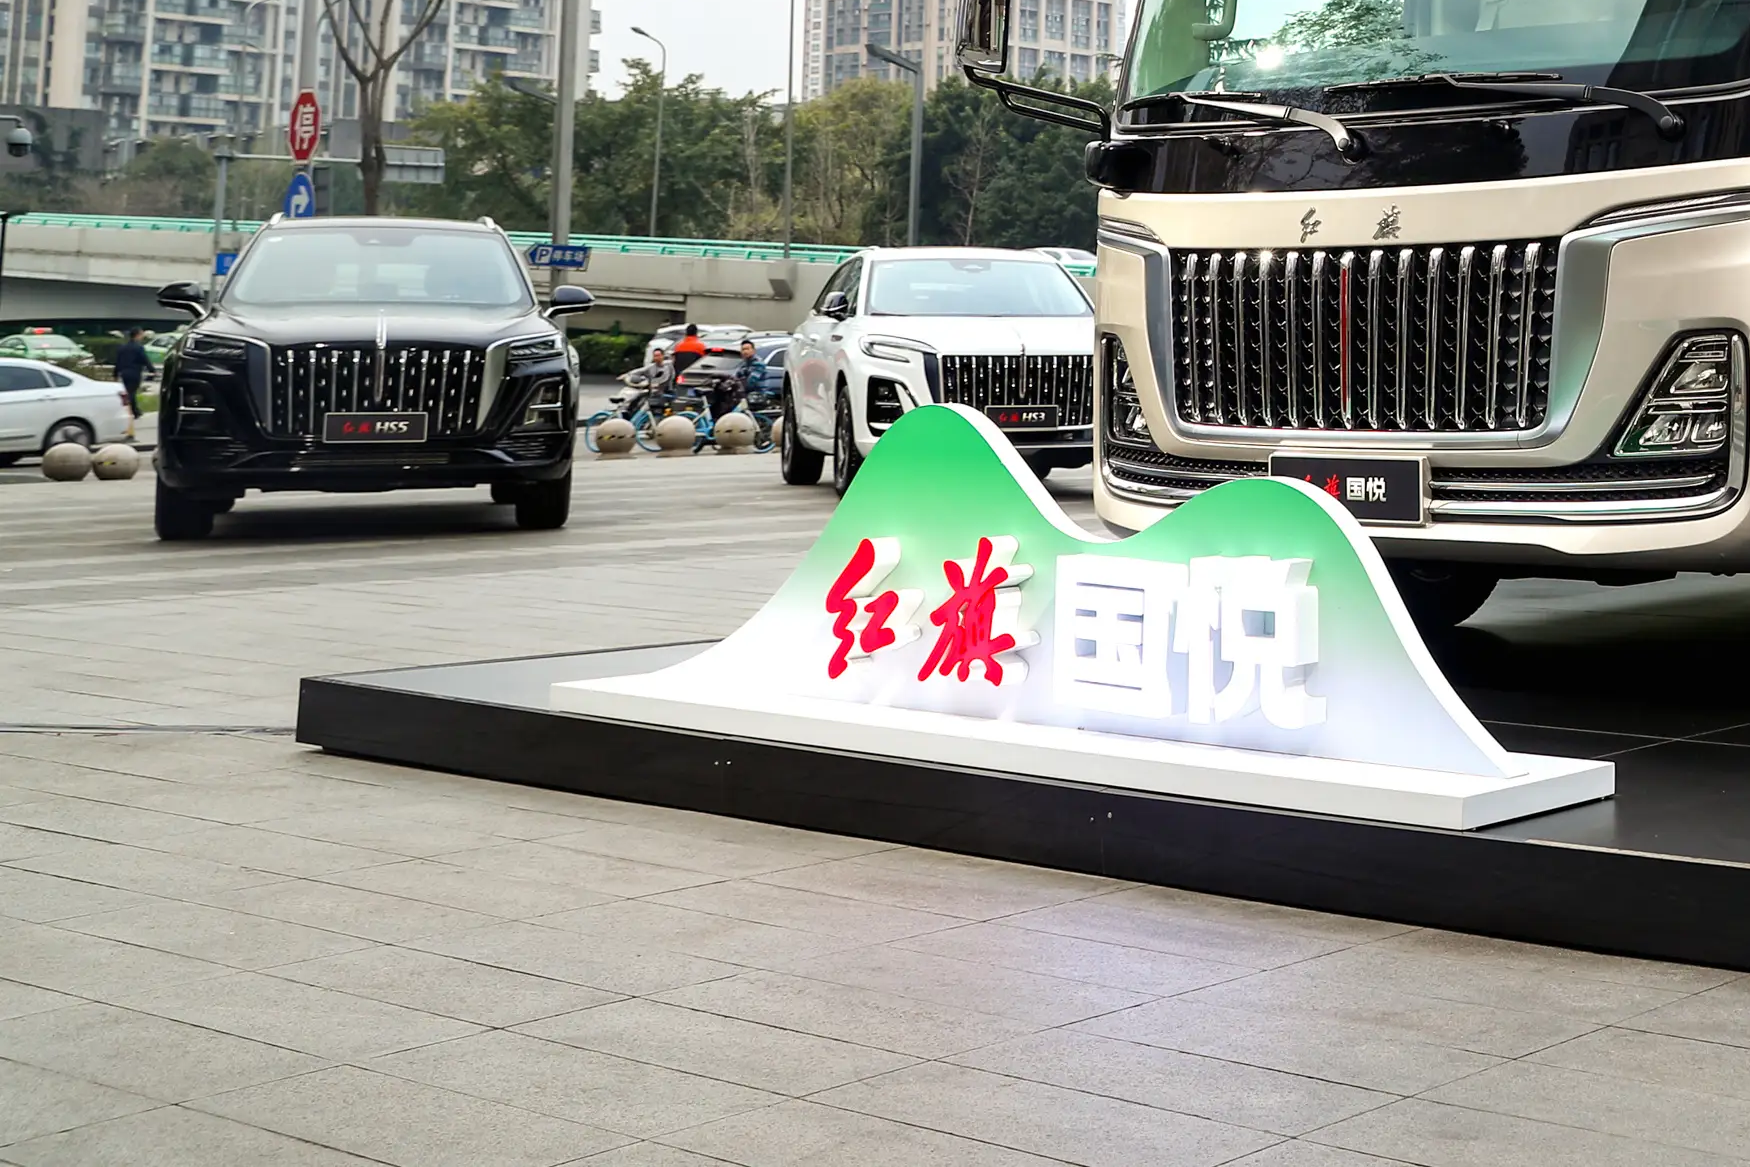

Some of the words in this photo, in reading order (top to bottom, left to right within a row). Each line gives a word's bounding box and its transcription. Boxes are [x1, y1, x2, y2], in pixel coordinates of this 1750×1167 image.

[295, 103, 315, 150] 停
[1300, 204, 1401, 243] 红旗
[375, 421, 409, 434] HS5
[1022, 412, 1046, 422] HS3
[1346, 477, 1387, 502] 国悦
[826, 536, 1018, 686] 红旗
[1054, 553, 1328, 730] 国悦
